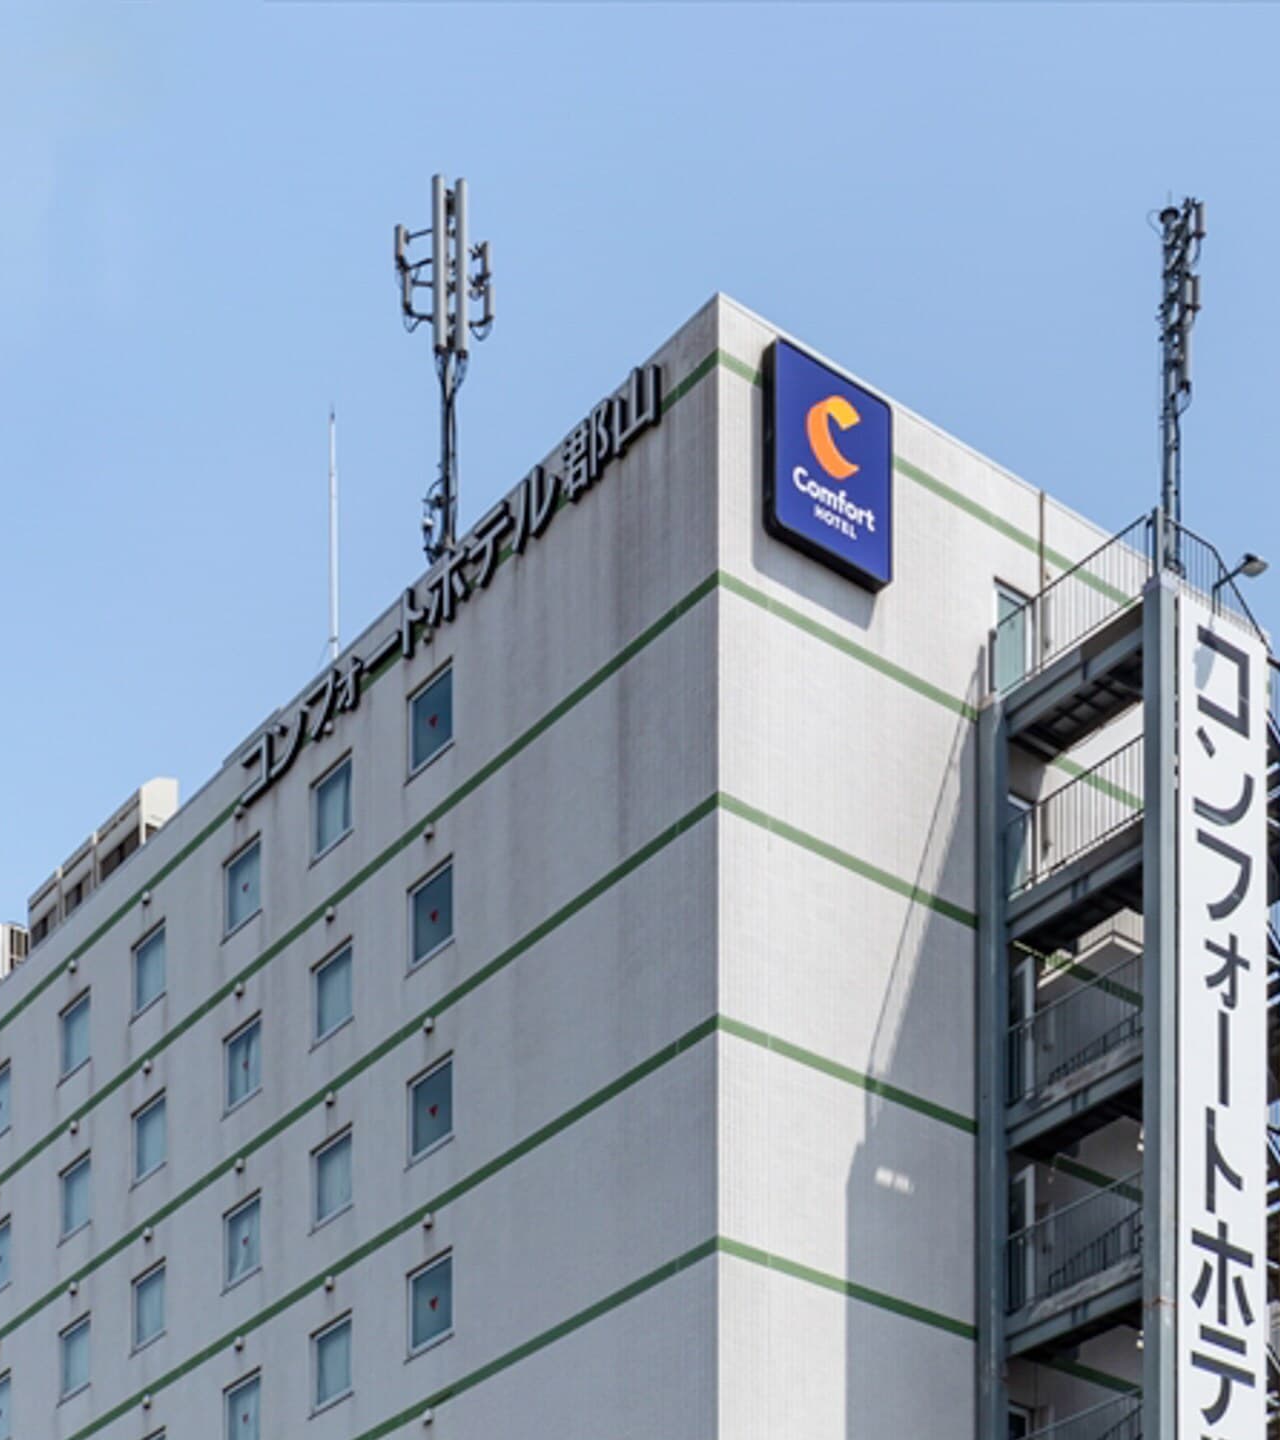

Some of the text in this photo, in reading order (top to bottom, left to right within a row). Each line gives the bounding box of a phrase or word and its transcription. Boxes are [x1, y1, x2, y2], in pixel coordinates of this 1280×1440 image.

[792, 466, 876, 533] Comfort
[813, 504, 858, 541] HOTEL
[239, 364, 663, 808] コンフォートホテル郡山
